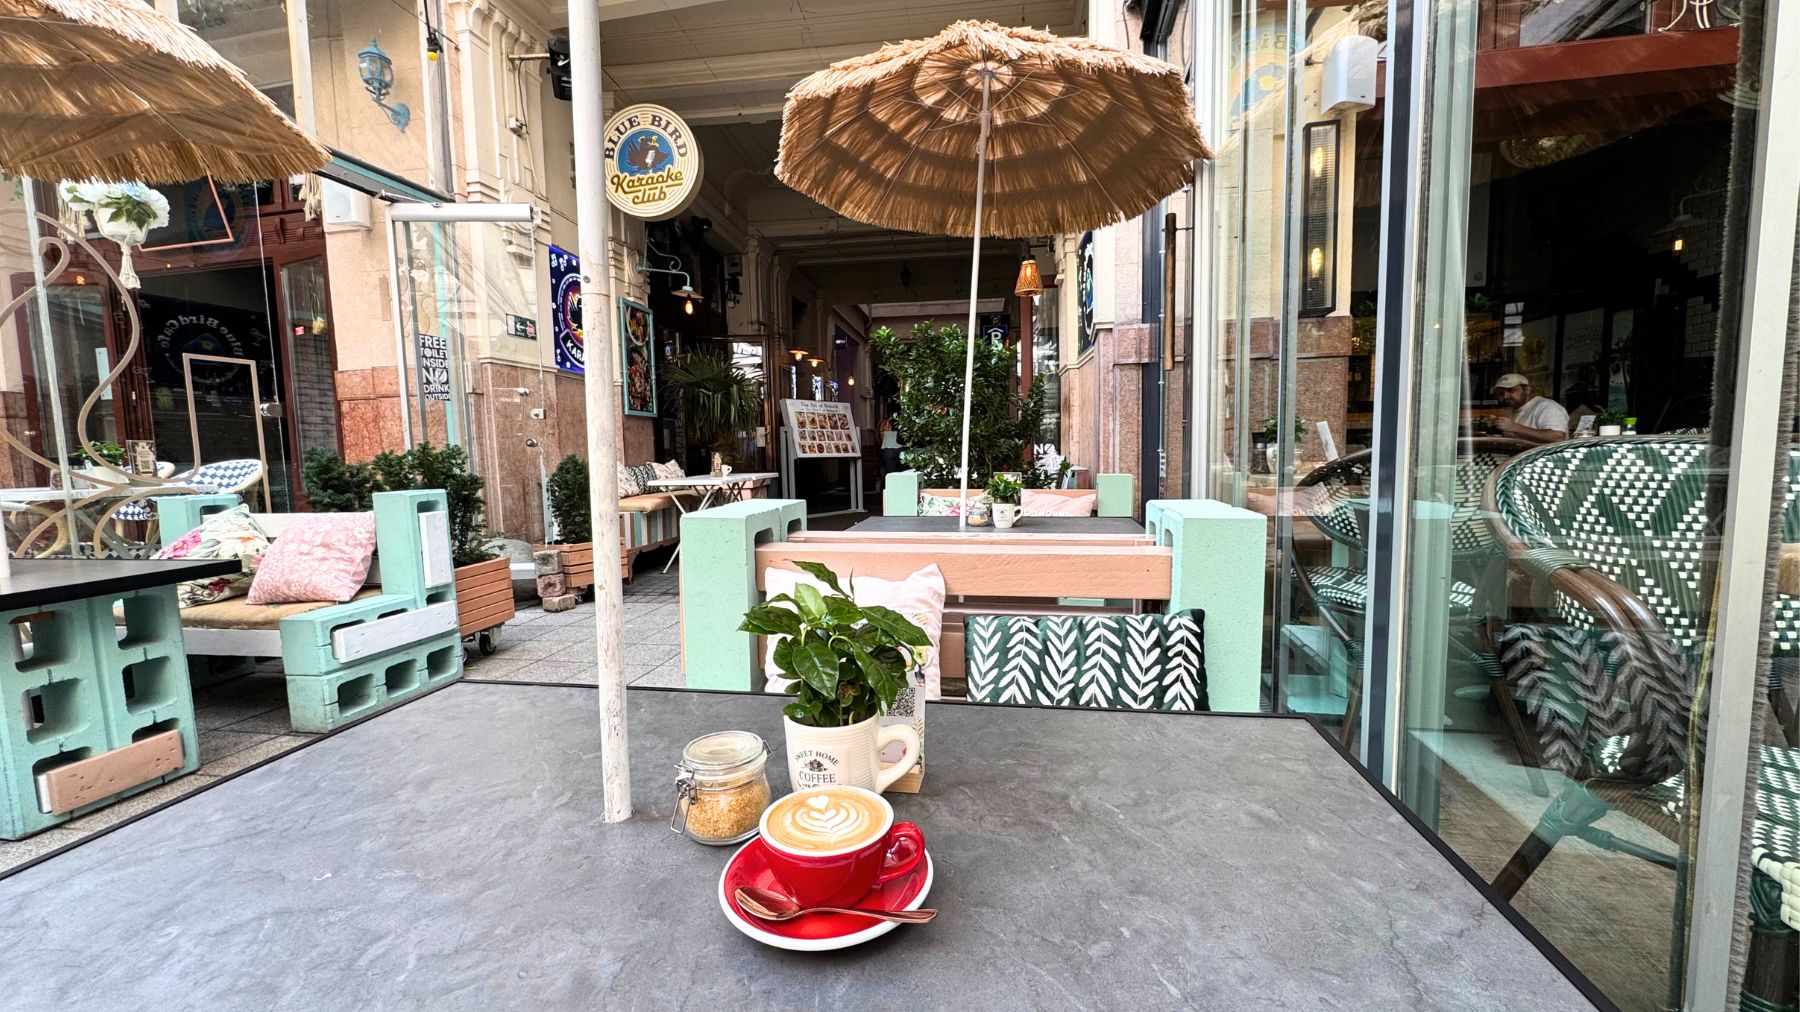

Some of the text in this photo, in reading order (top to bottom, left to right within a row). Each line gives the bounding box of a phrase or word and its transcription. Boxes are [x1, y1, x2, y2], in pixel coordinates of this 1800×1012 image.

[604, 114, 688, 160] BLUE BIRD
[610, 167, 684, 194] Karaoke
[632, 185, 667, 205] club
[419, 335, 447, 349] FREE
[991, 331, 1002, 345] P
[420, 347, 448, 358] TOILET
[422, 367, 448, 384] NO
[424, 384, 450, 393] DRINK
[815, 751, 840, 766] HOME
[799, 771, 836, 784] COFFEE
